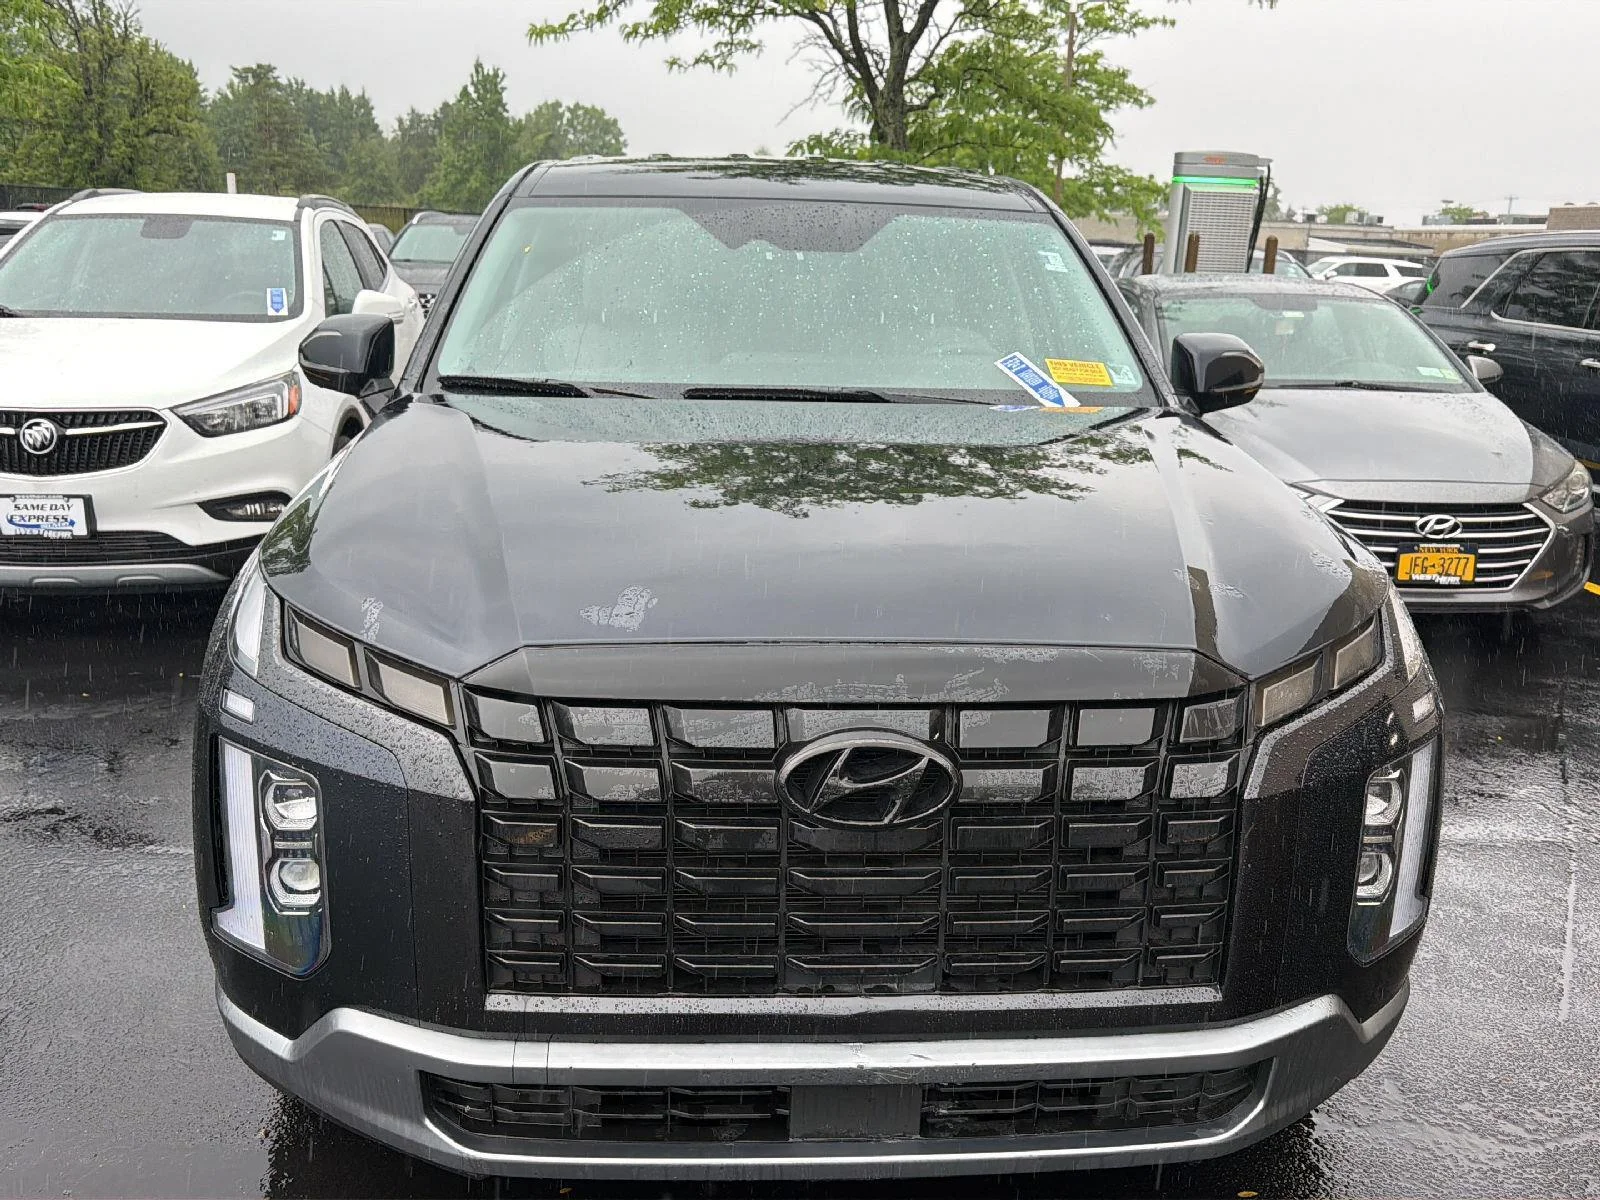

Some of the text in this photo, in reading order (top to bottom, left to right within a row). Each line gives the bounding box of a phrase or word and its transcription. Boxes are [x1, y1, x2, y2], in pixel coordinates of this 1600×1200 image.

[14, 503, 73, 511] SAME DAY
[9, 514, 70, 523] EXPRESS
